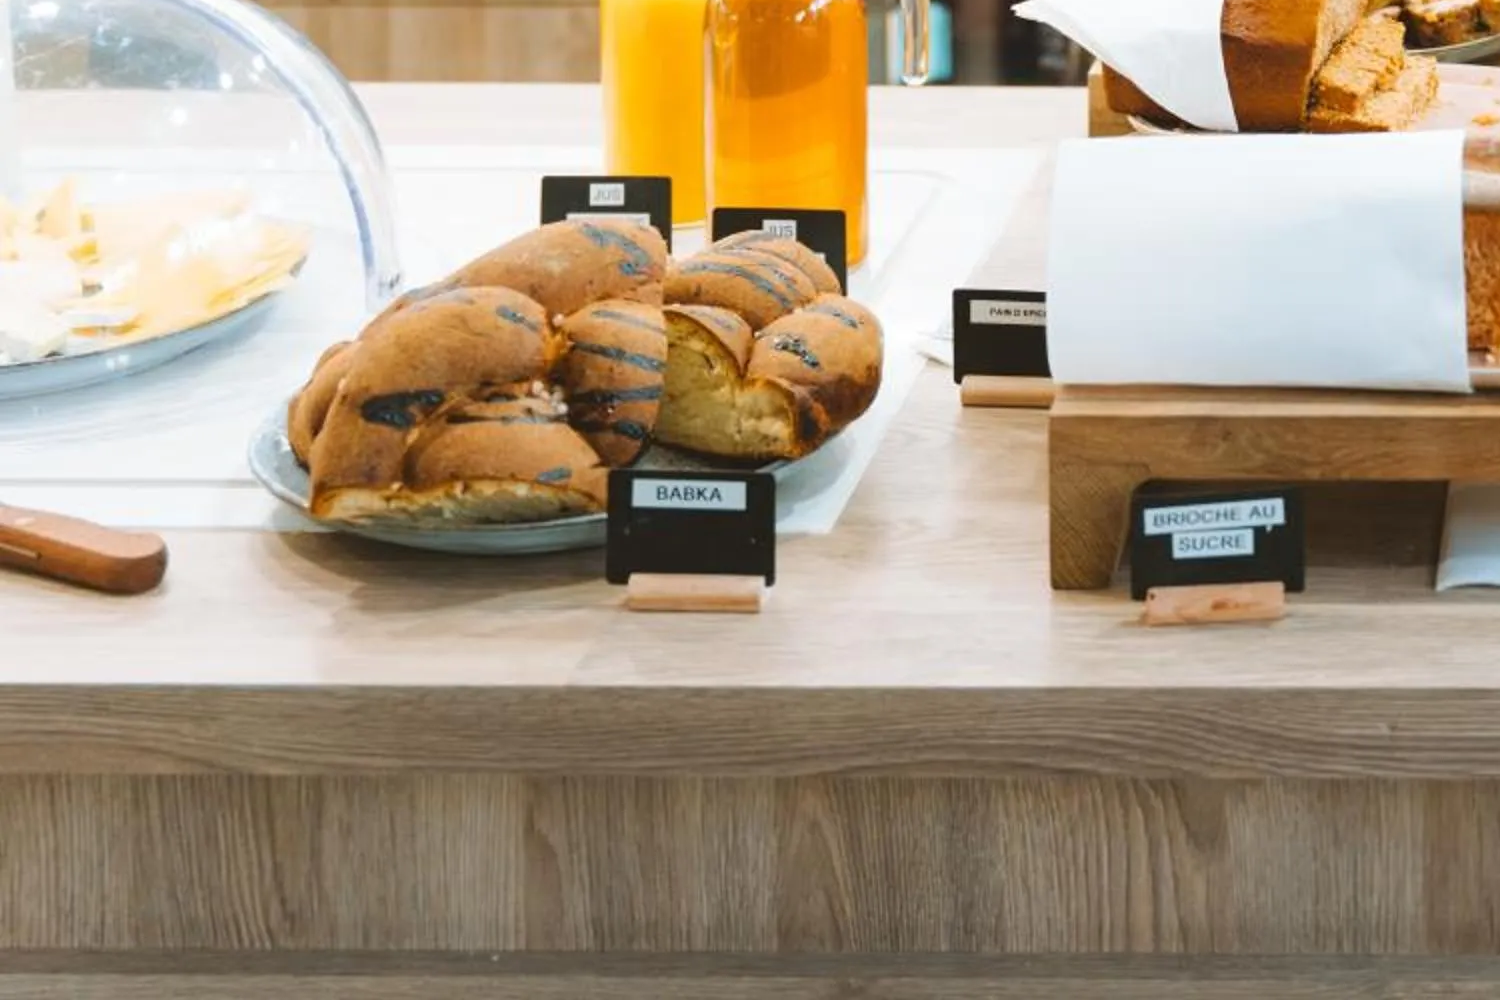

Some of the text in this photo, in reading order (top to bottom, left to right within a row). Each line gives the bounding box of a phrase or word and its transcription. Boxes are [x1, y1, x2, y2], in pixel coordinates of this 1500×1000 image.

[656, 485, 723, 502] BABKA
[1152, 503, 1277, 527] BRIOCHE AU
[1178, 533, 1248, 552] SUCRE
